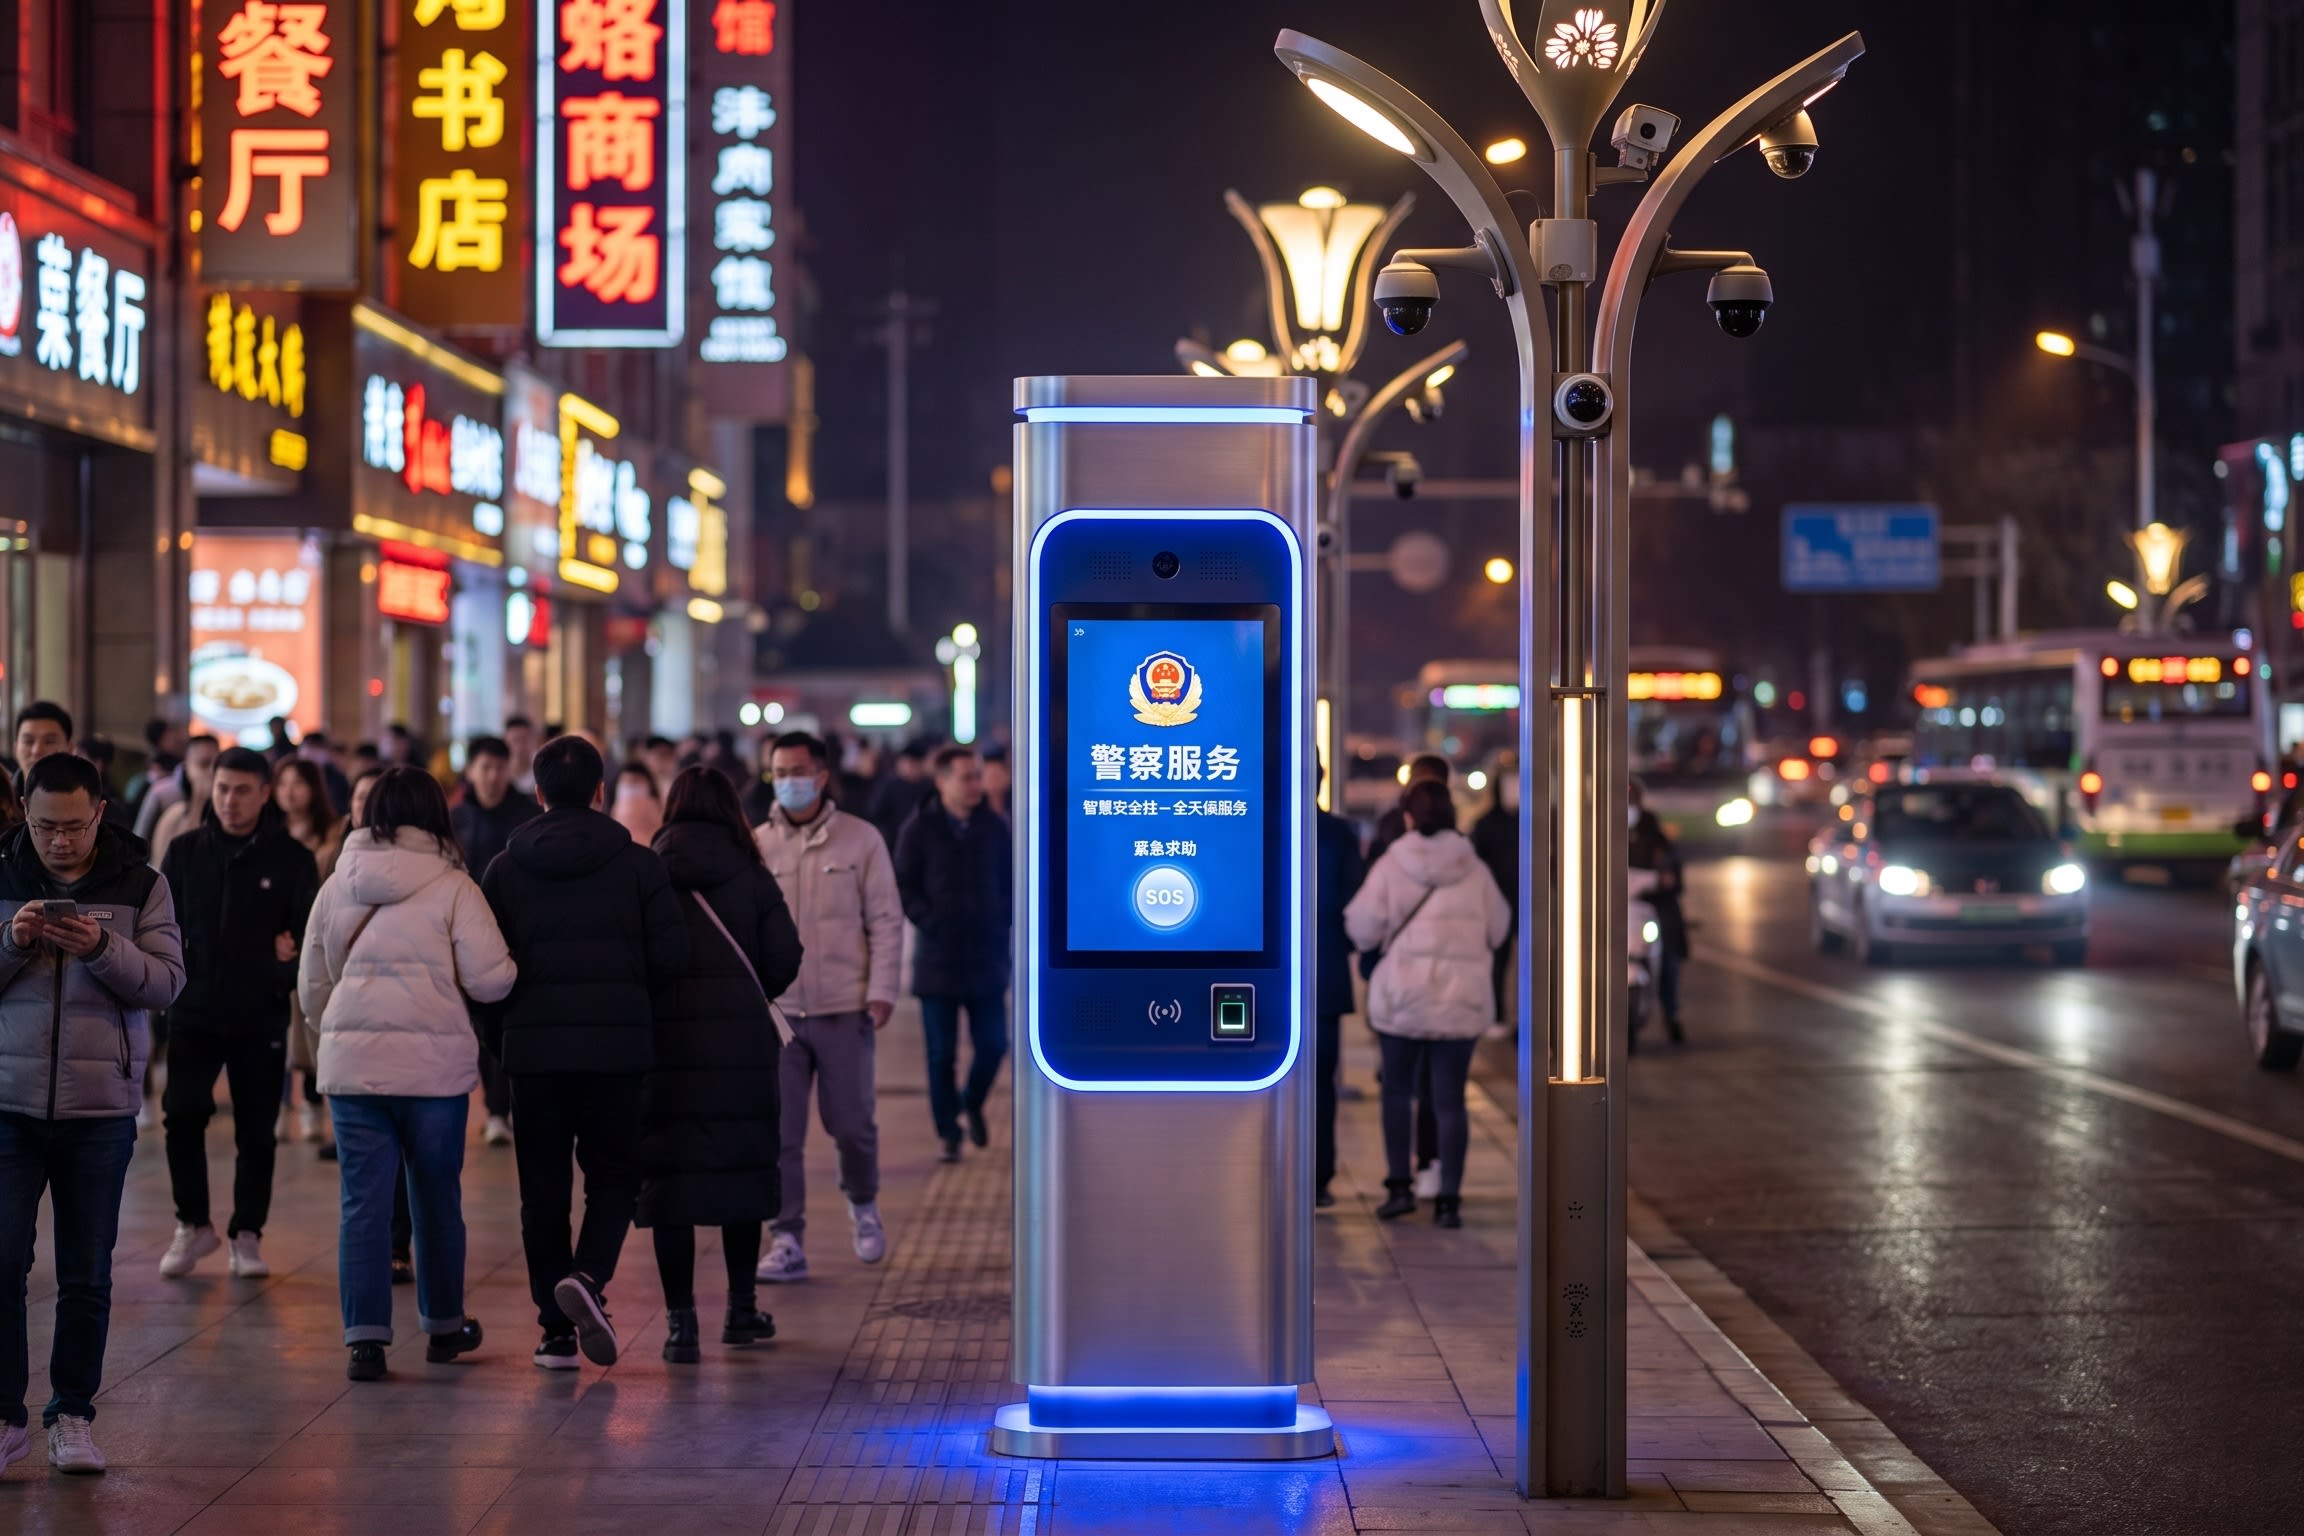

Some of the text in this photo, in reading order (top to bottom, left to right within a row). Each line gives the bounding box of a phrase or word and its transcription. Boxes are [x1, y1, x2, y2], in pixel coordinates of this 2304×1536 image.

[217, 0, 333, 236] 餐厅
[1090, 744, 1240, 781] 警察服务
[1133, 839, 1197, 857] 紧急求助
[1145, 889, 1185, 905] SOS
